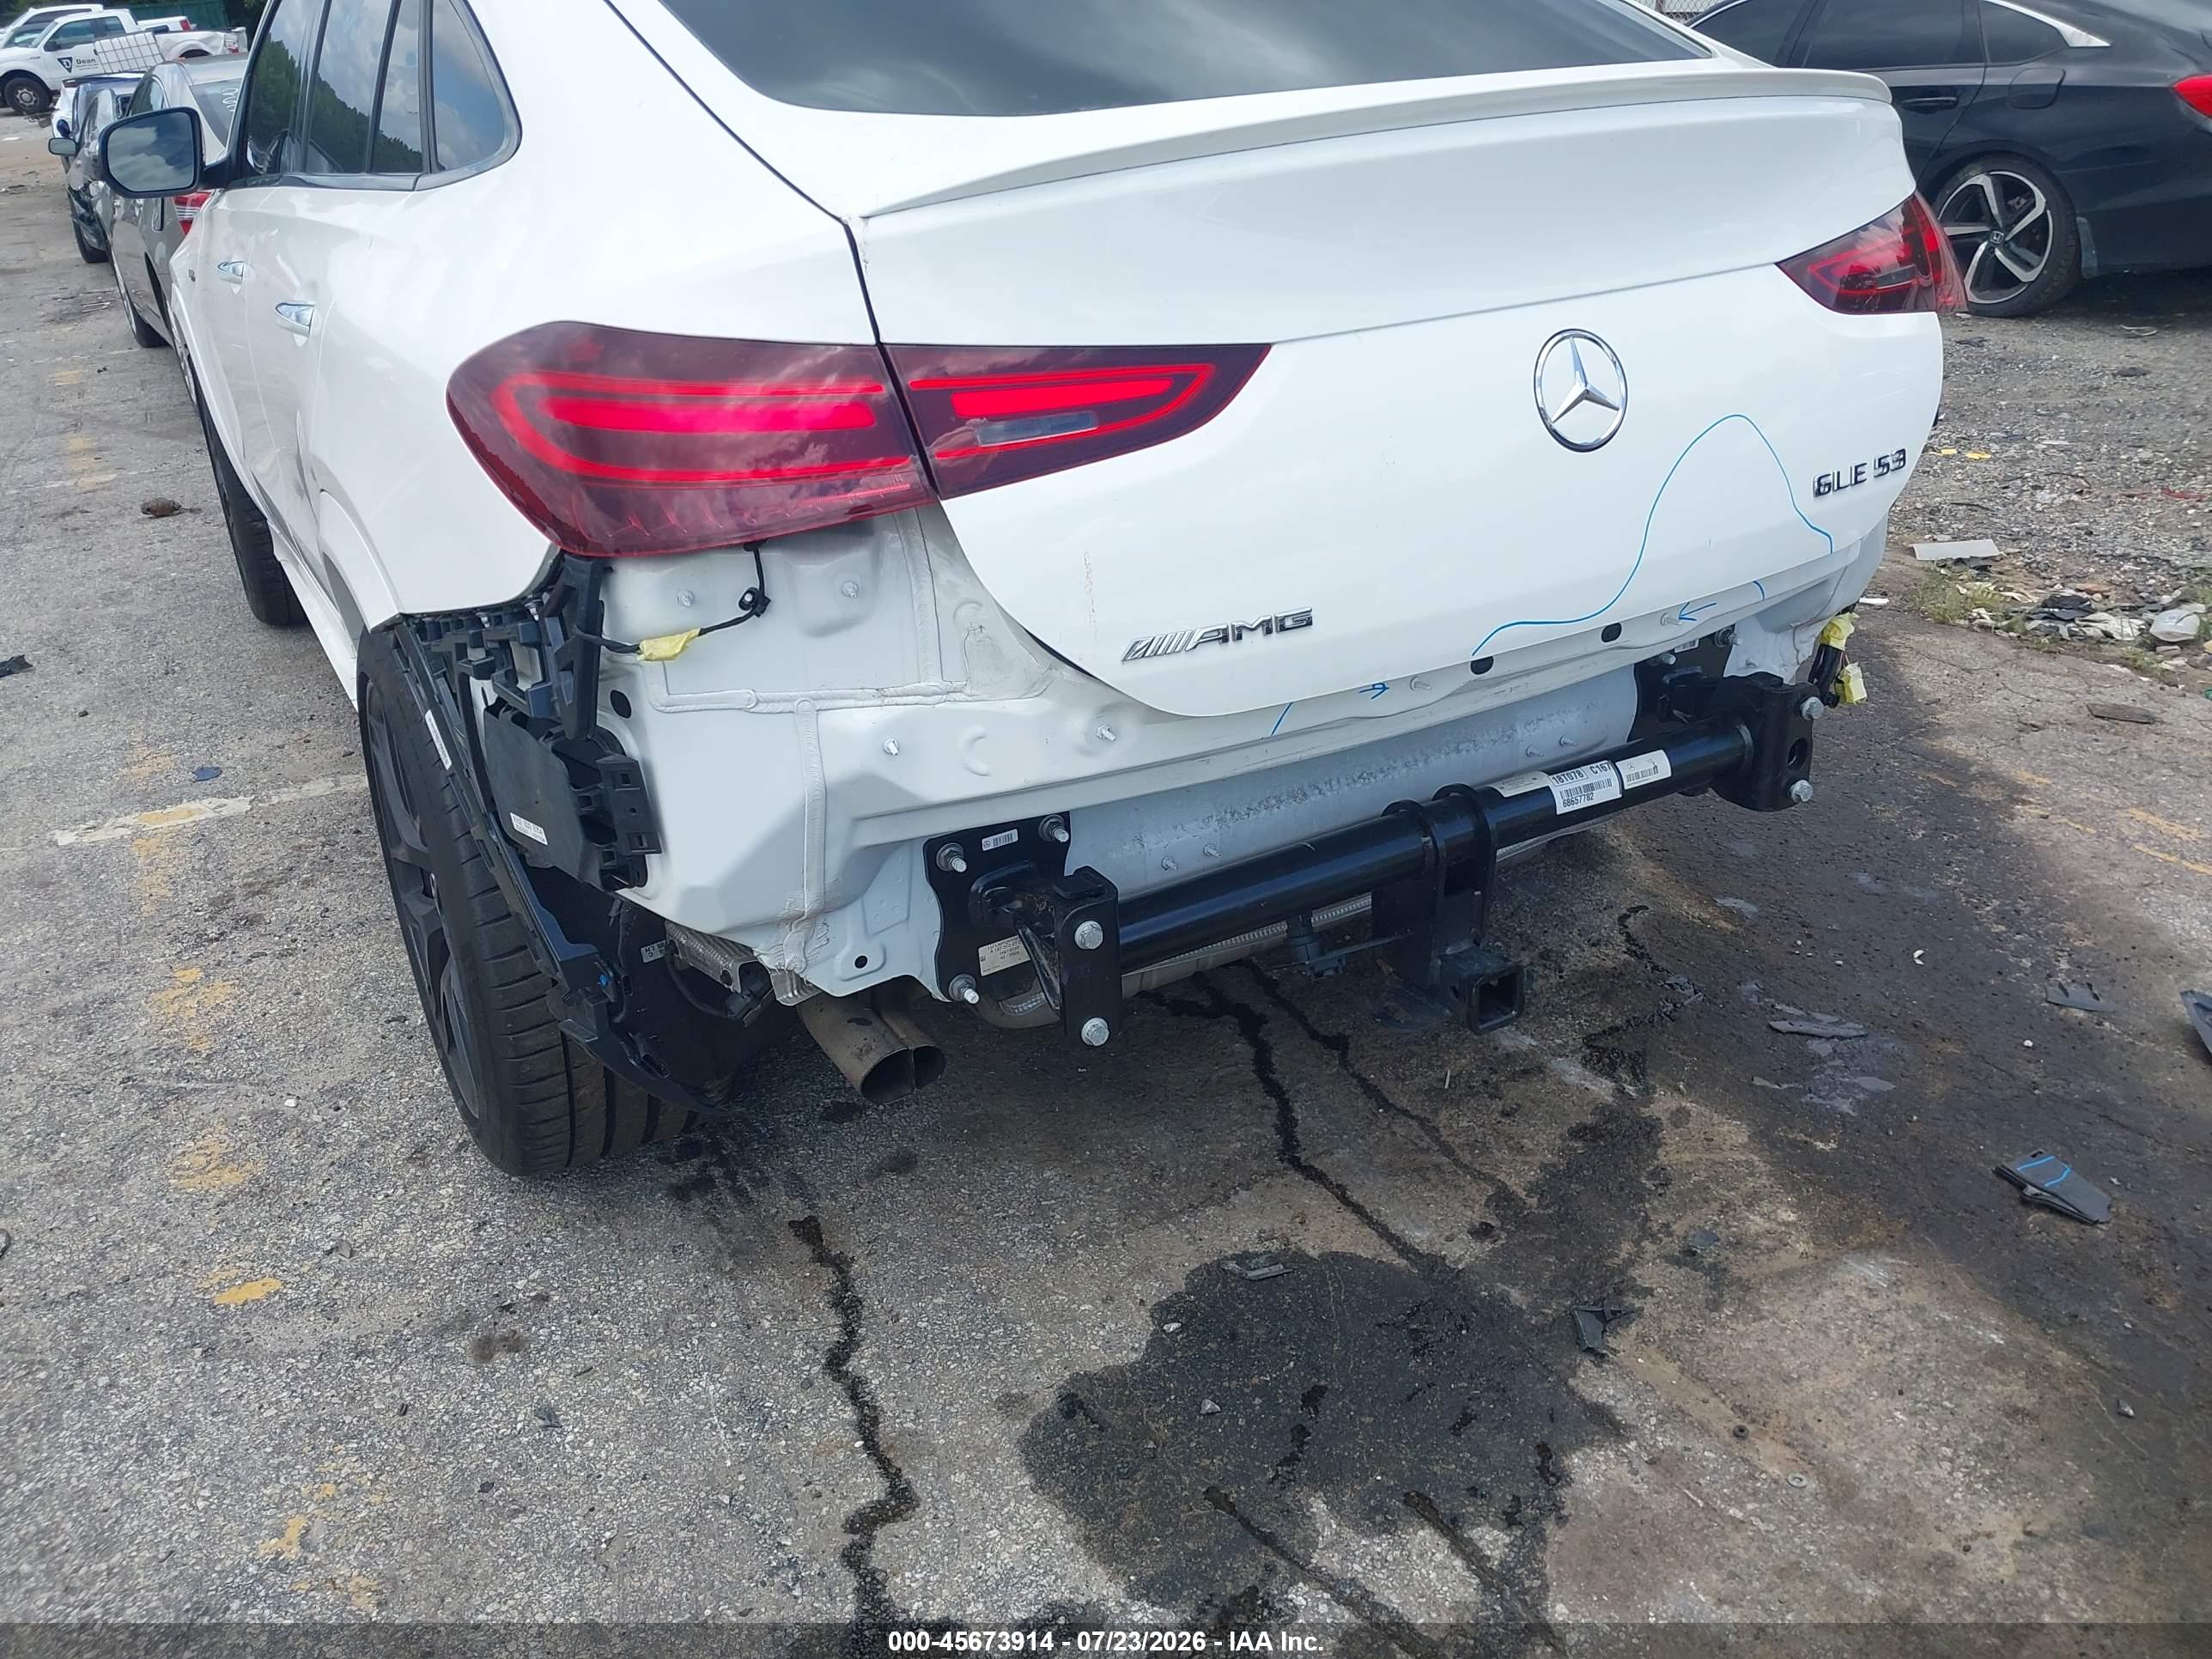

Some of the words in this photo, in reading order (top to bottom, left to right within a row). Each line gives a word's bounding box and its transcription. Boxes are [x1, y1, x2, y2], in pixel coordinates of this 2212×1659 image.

[1813, 462, 1868, 498] GLE
[1874, 447, 1906, 478] 53
[1185, 606, 1313, 652] AMG
